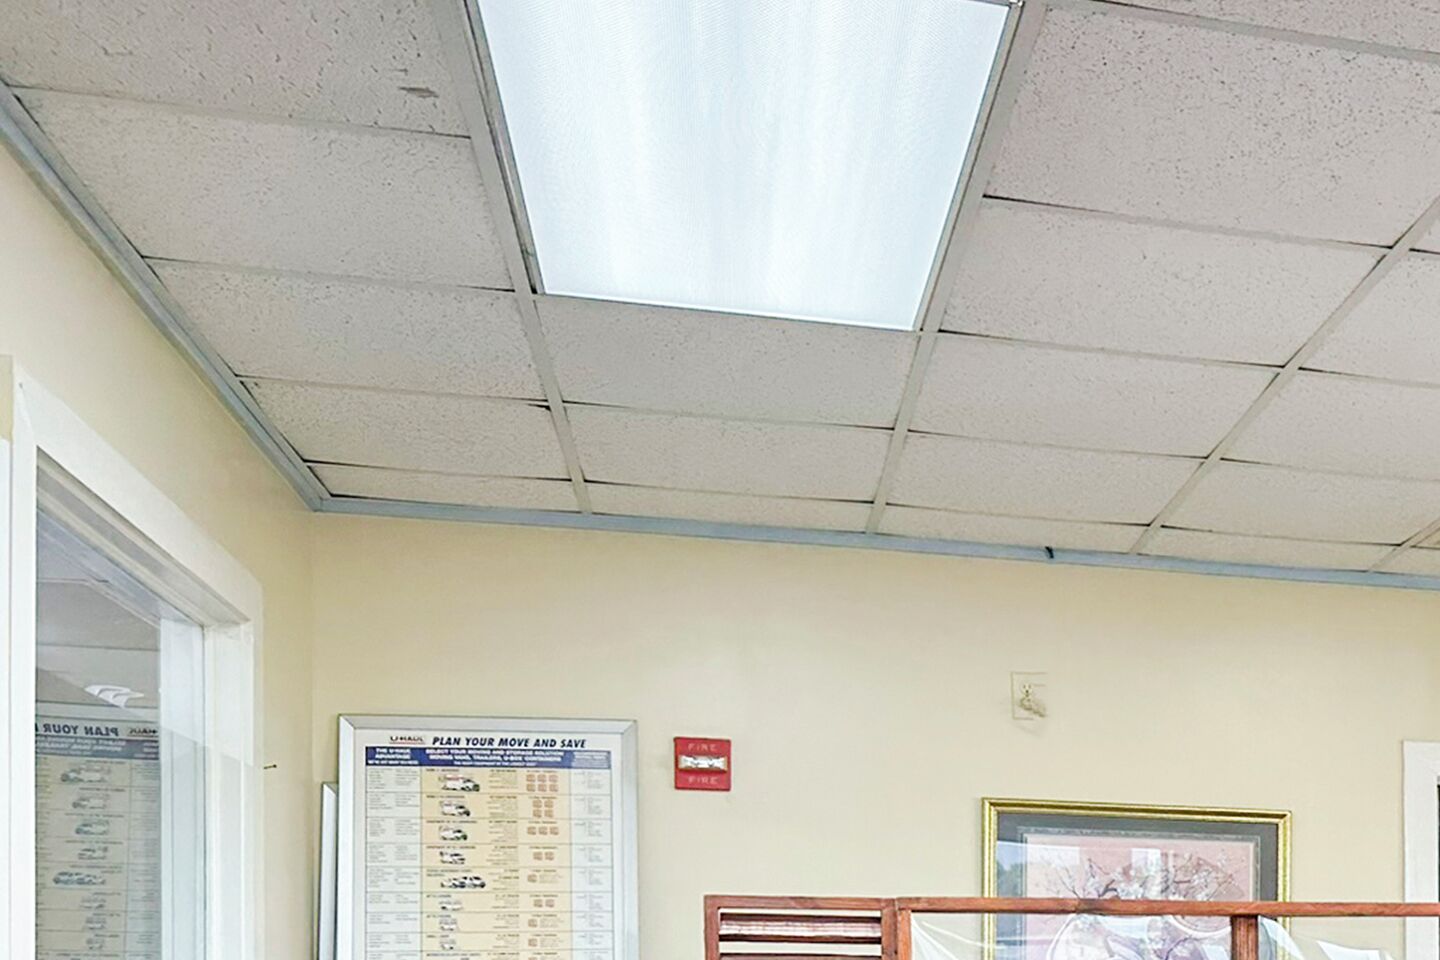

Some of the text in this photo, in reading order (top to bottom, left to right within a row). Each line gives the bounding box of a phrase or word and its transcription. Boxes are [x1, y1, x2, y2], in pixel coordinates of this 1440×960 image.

[432, 736, 586, 749] PLAN YOUR MOVE AND SAVE
[688, 743, 717, 751] FIRE
[688, 776, 718, 785] FIRE
